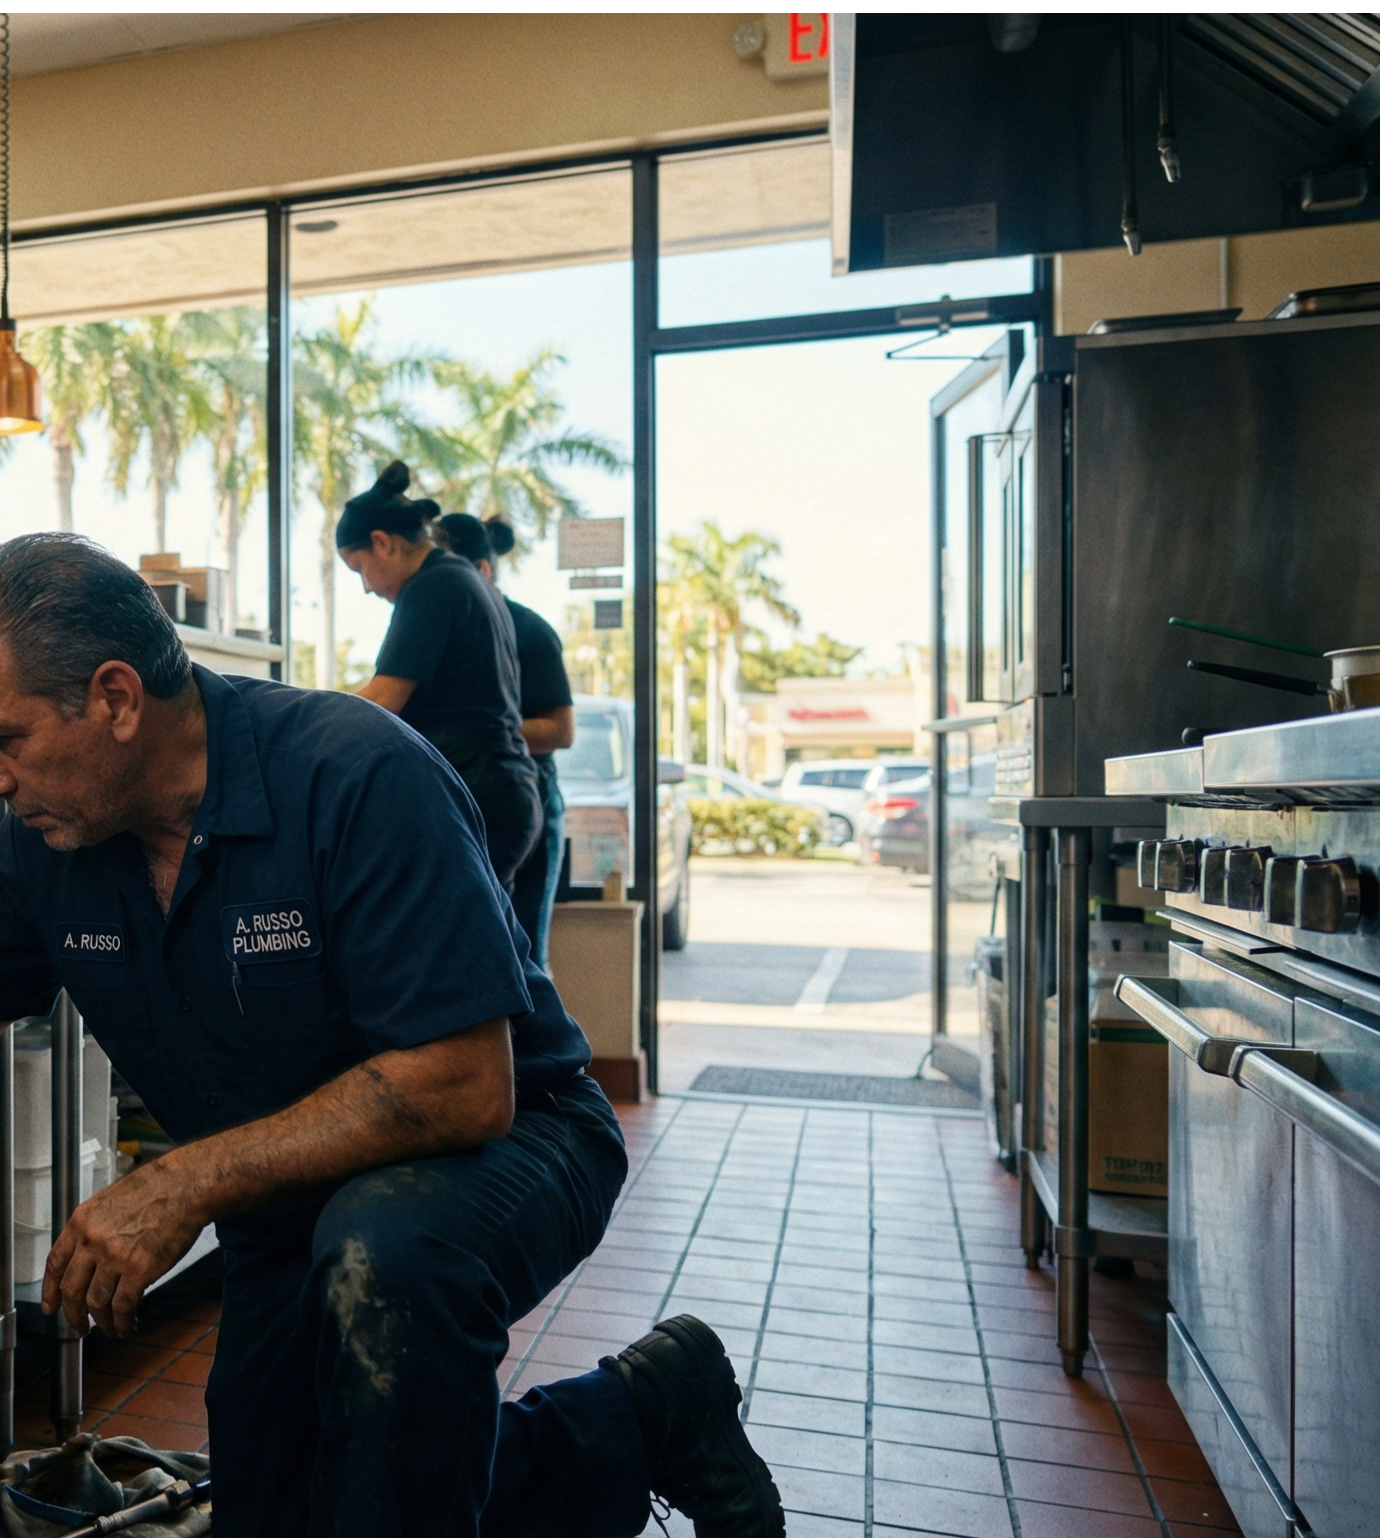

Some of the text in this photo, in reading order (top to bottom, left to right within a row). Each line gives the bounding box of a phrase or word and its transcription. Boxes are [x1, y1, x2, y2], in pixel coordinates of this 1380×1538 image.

[236, 910, 303, 934] A. RUSSO
[64, 932, 121, 951] A. RUSSO
[232, 930, 311, 954] PLUMBING
